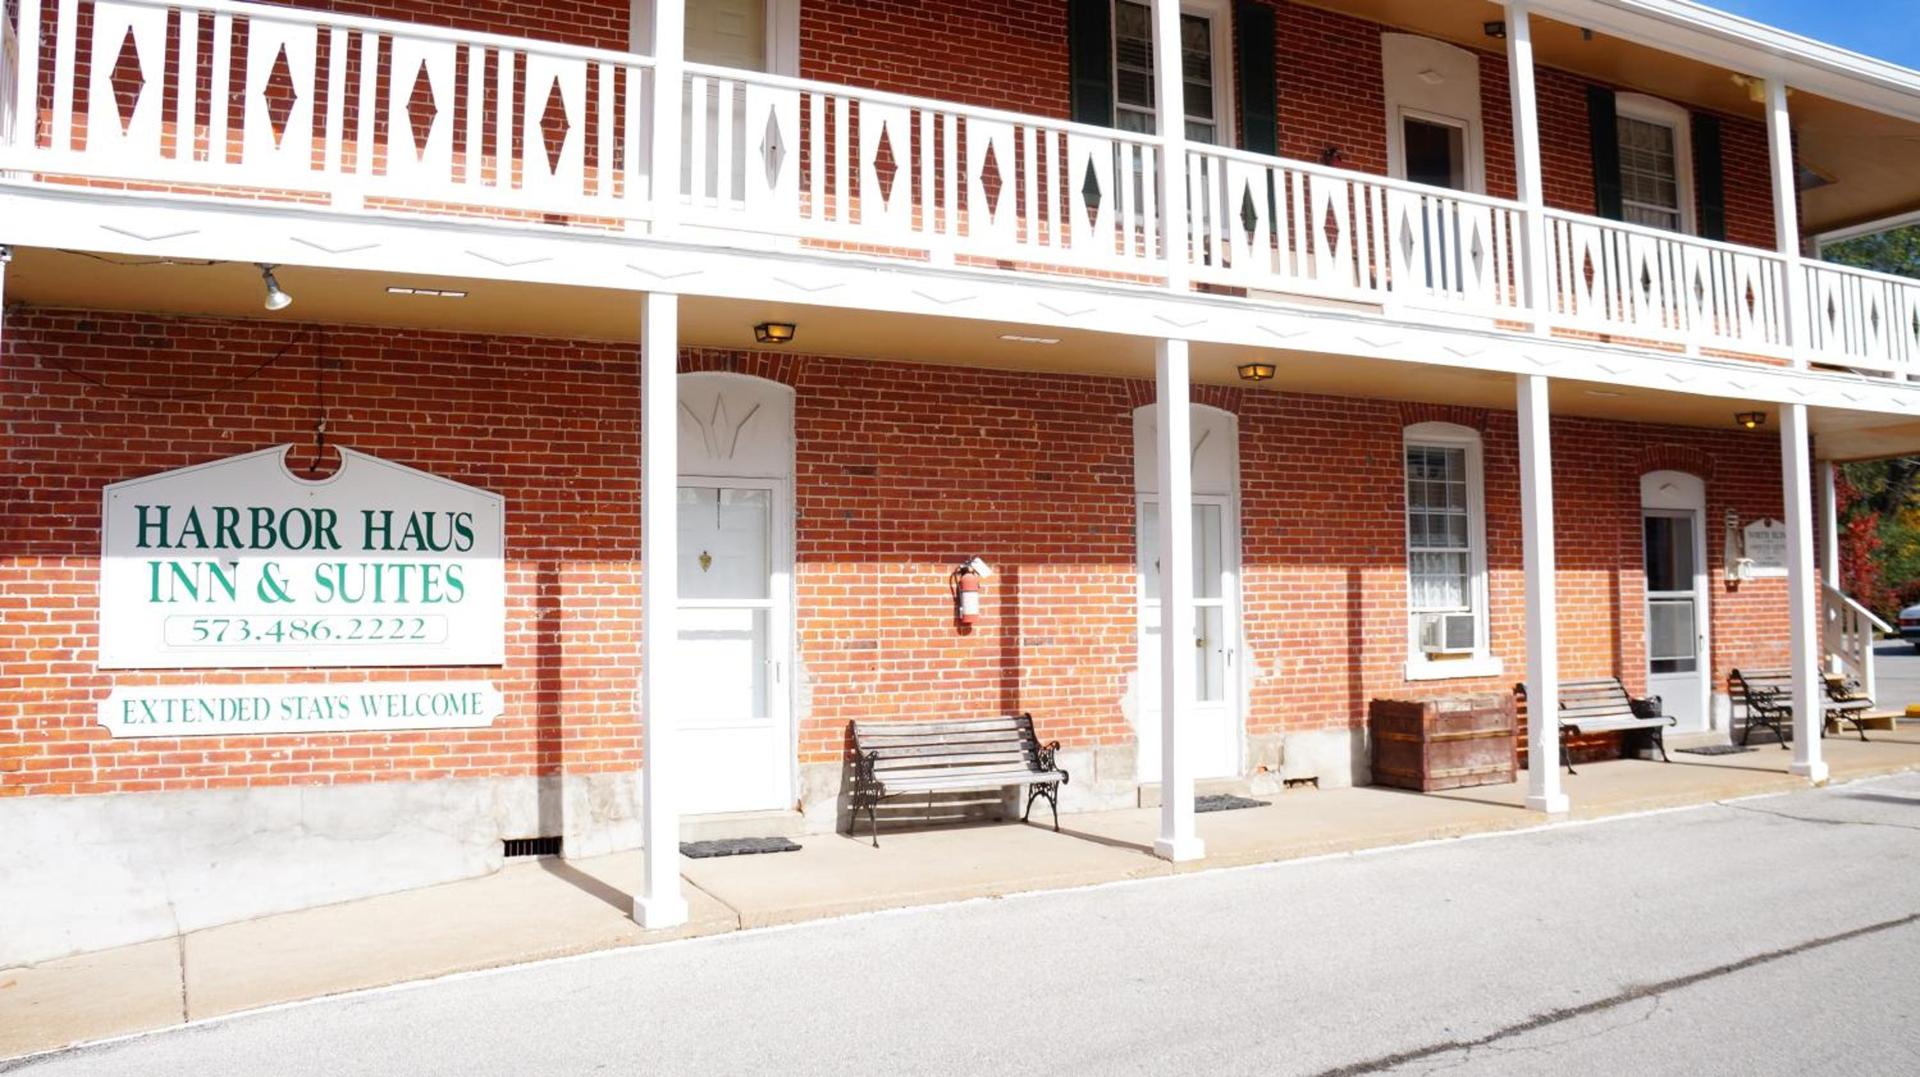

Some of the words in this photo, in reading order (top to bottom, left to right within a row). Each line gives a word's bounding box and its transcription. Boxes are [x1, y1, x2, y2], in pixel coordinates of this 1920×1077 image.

[134, 504, 342, 550] HARBOR
[361, 509, 475, 552] HAUS
[147, 560, 238, 603] INN
[256, 561, 296, 604] &
[314, 562, 465, 604] SUITES
[192, 616, 426, 643] 573.486.2222
[122, 697, 271, 725] EXTENDED
[280, 695, 350, 721] STAYS
[360, 691, 484, 718] WELCOME
